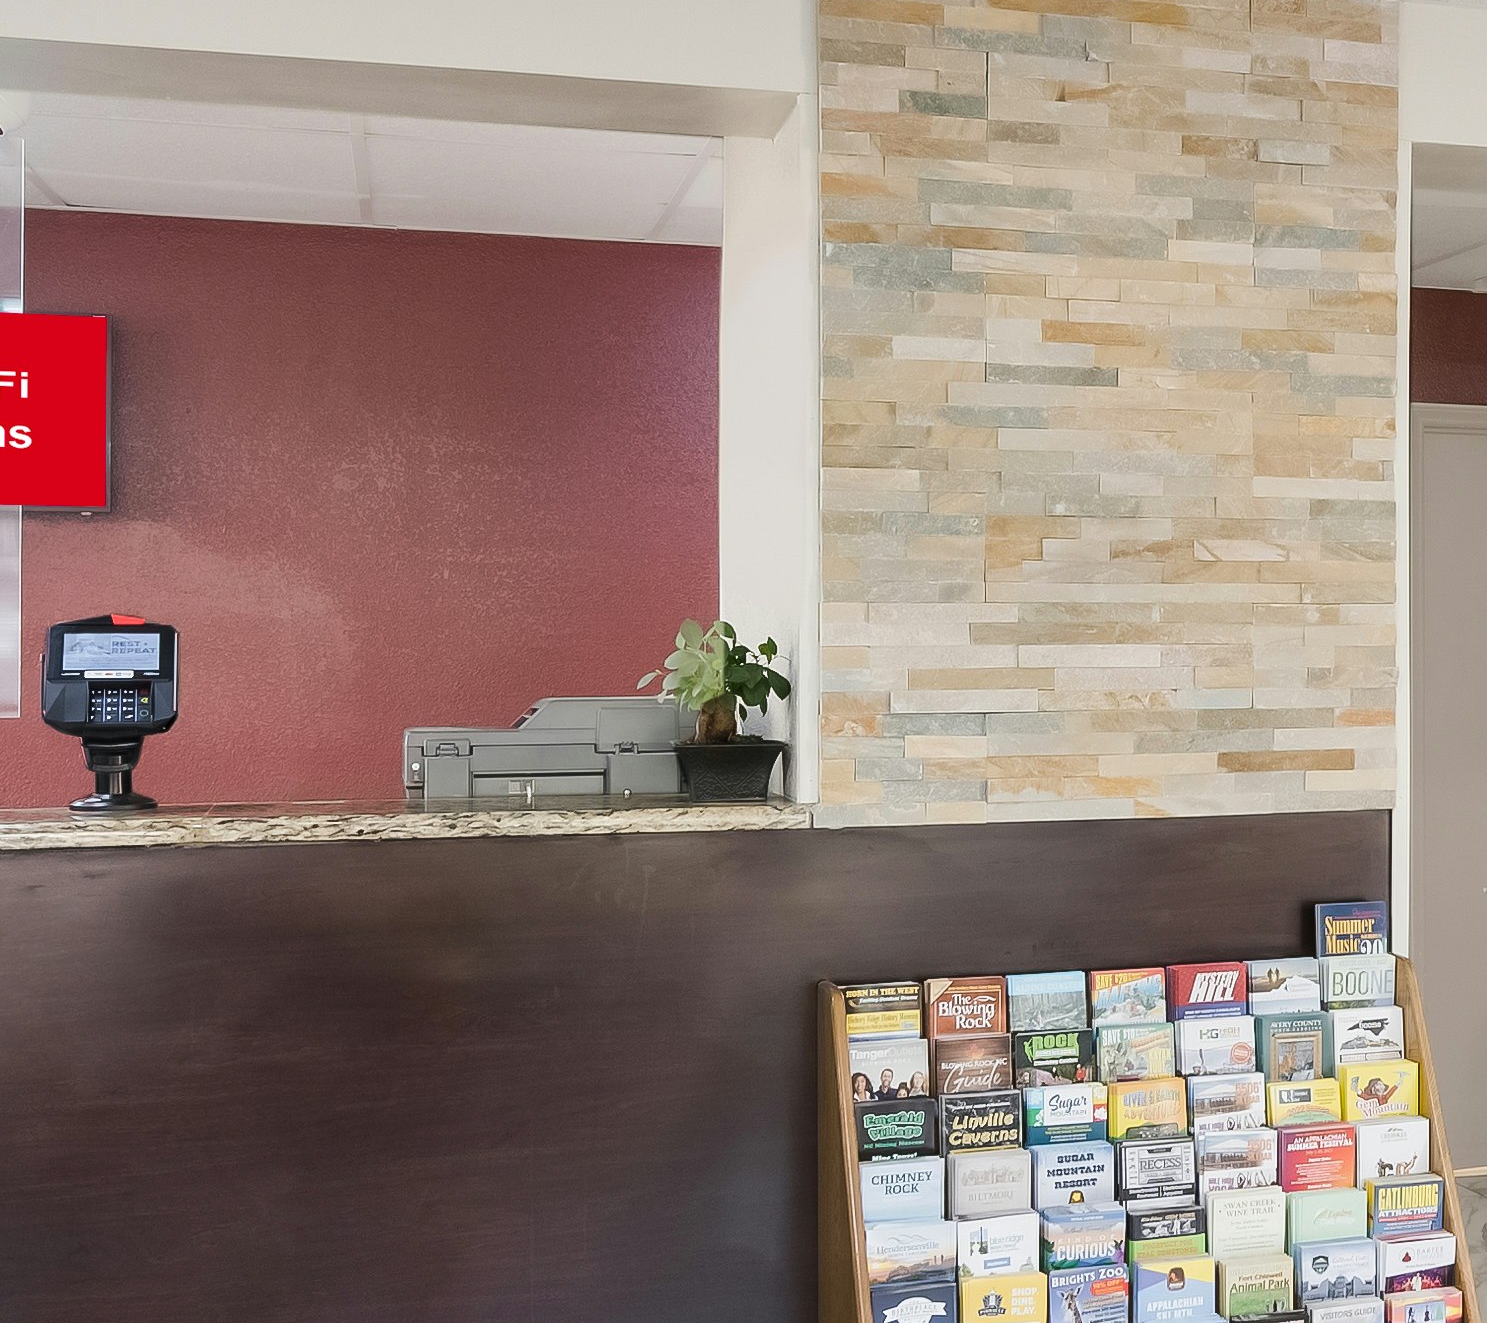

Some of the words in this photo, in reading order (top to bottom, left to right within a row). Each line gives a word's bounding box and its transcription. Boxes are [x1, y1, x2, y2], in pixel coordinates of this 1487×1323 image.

[112, 640, 141, 648] REST
[1325, 915, 1375, 936] Summer
[1325, 933, 1361, 955] Music
[1095, 974, 1113, 991] SAVE
[1332, 969, 1394, 997] BOONE
[870, 987, 879, 997] IN
[880, 987, 896, 996] THE
[896, 986, 920, 995] WEST
[952, 994, 973, 1005] The
[939, 1002, 996, 1019] Blowing
[956, 1012, 992, 1030] Rock
[1270, 1021, 1292, 1029] AVERY
[1292, 1019, 1322, 1028] COUNTY
[1032, 1033, 1080, 1049] ROCK
[1102, 1029, 1121, 1047] SAVE
[941, 1061, 974, 1070] BLOWING
[944, 1062, 1003, 1093] Guide
[1048, 1094, 1087, 1113] Sugar
[1355, 1099, 1379, 1111] Gem
[1363, 1103, 1409, 1118] Mountain
[863, 1110, 925, 1128] Emerald
[1050, 1109, 1087, 1118] MOUNTAIN
[952, 1112, 1015, 1130] Linville
[867, 1126, 923, 1141] Village
[949, 1128, 1018, 1146] Caverns
[1305, 1133, 1347, 1143] APPALACHIAN
[1287, 1142, 1319, 1152] SUMMER
[1320, 1138, 1353, 1149] FESTIVAL
[1057, 1153, 1095, 1164] SUGAR
[1140, 1157, 1182, 1170] RECESS
[1046, 1164, 1105, 1177] MOUNTAIN
[871, 1171, 933, 1185] CHIMNEY
[1054, 1178, 1098, 1190] RESORT
[885, 1183, 920, 1196] ROCK
[968, 1190, 1016, 1202] BILTMORE
[1223, 1200, 1249, 1209] SWAN
[1250, 1198, 1277, 1207] CREEK
[1378, 1184, 1439, 1210] GATLINBURG
[1226, 1209, 1248, 1218] WINE
[1252, 1206, 1275, 1215] TRAIL
[1378, 1208, 1439, 1218] ATTRACTIONS
[1004, 1234, 1025, 1245] ridge
[876, 1242, 940, 1256] Hendersonville
[1056, 1241, 1116, 1261] CURIOUS
[1051, 1270, 1096, 1288] BRIGHTS
[1098, 1267, 1125, 1281] ZOO
[1238, 1274, 1253, 1282] Fort
[1231, 1279, 1266, 1293] Animal
[1268, 1278, 1290, 1289] Park
[1010, 1306, 1036, 1316] PLAY.
[1147, 1296, 1204, 1312] APPALACHIAN
[1320, 1308, 1353, 1321] VISITORS
[1354, 1307, 1377, 1317] GUIDE
